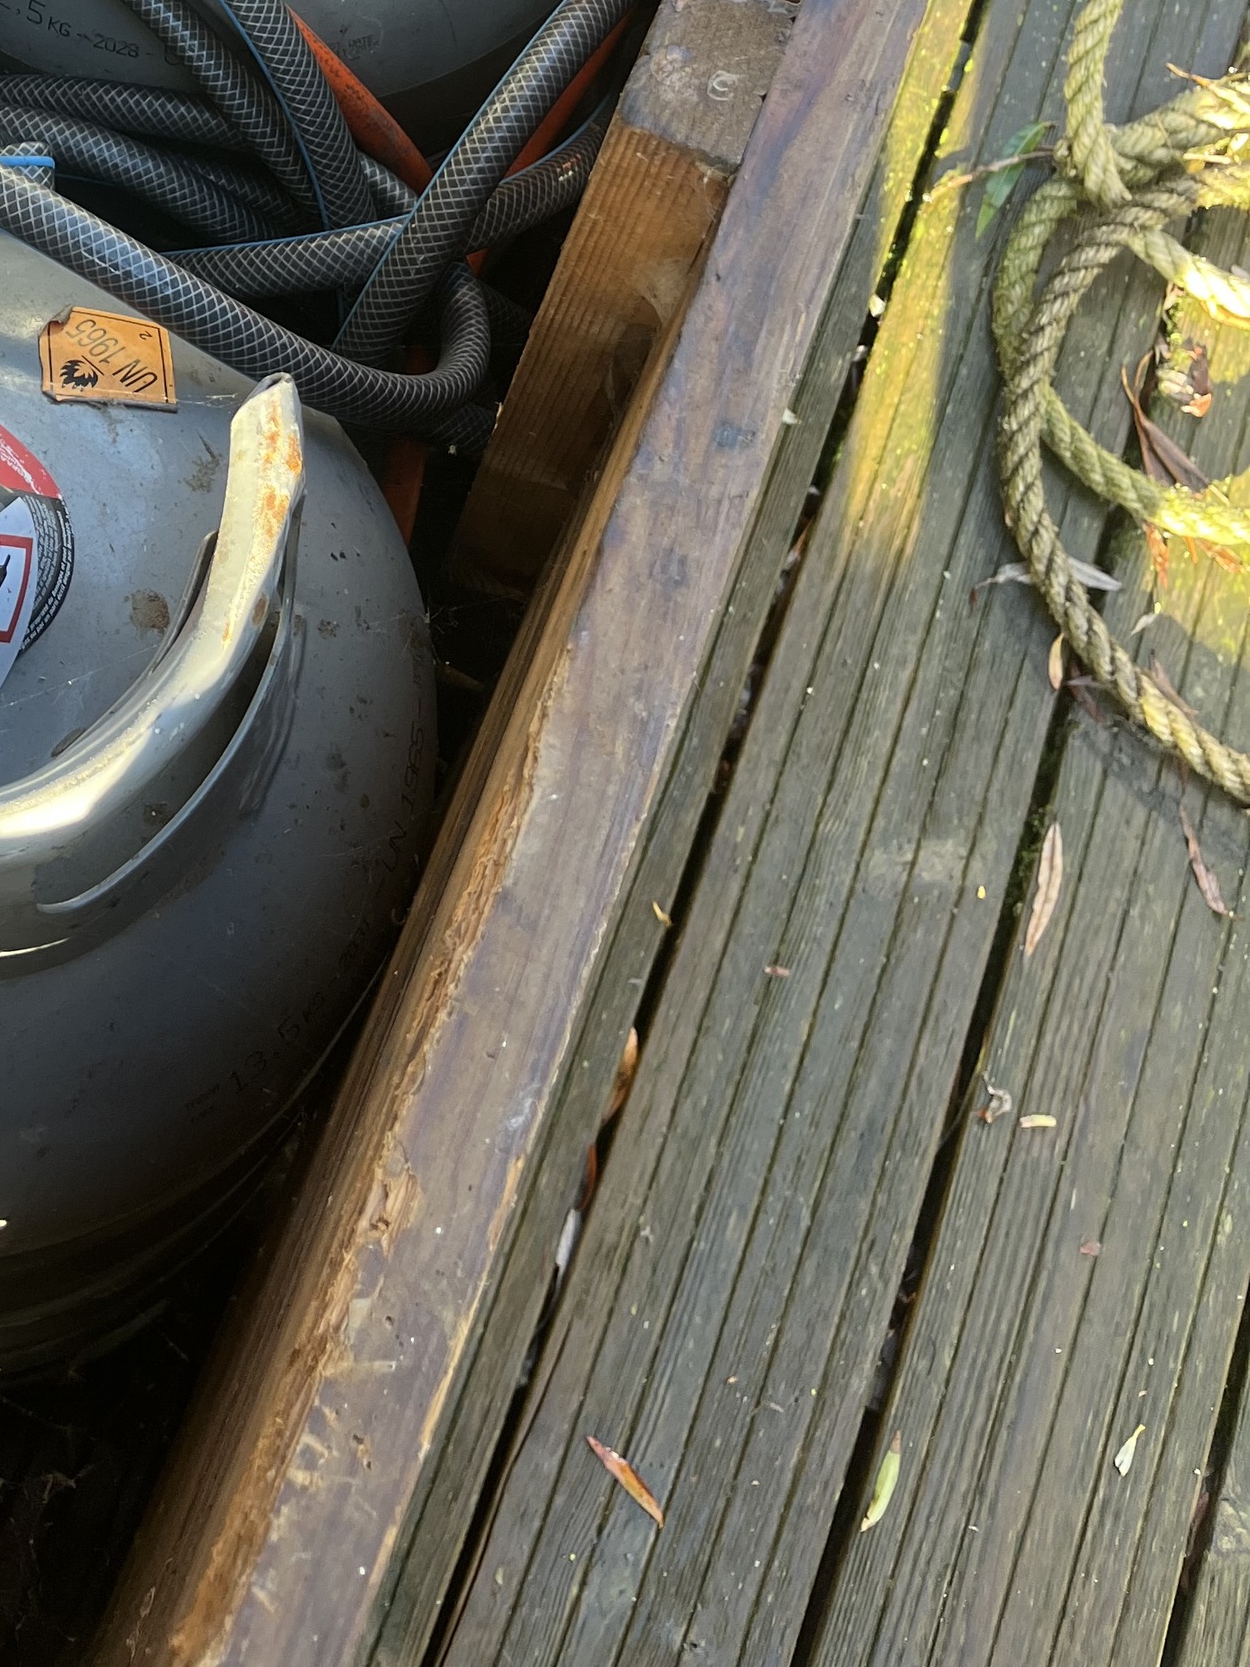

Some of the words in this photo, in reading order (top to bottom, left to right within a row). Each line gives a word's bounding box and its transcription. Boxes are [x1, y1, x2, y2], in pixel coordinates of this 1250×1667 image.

[93, 32, 141, 59] 2028
[64, 318, 126, 365] 1965
[139, 330, 153, 341] 2
[111, 357, 158, 394] UN
